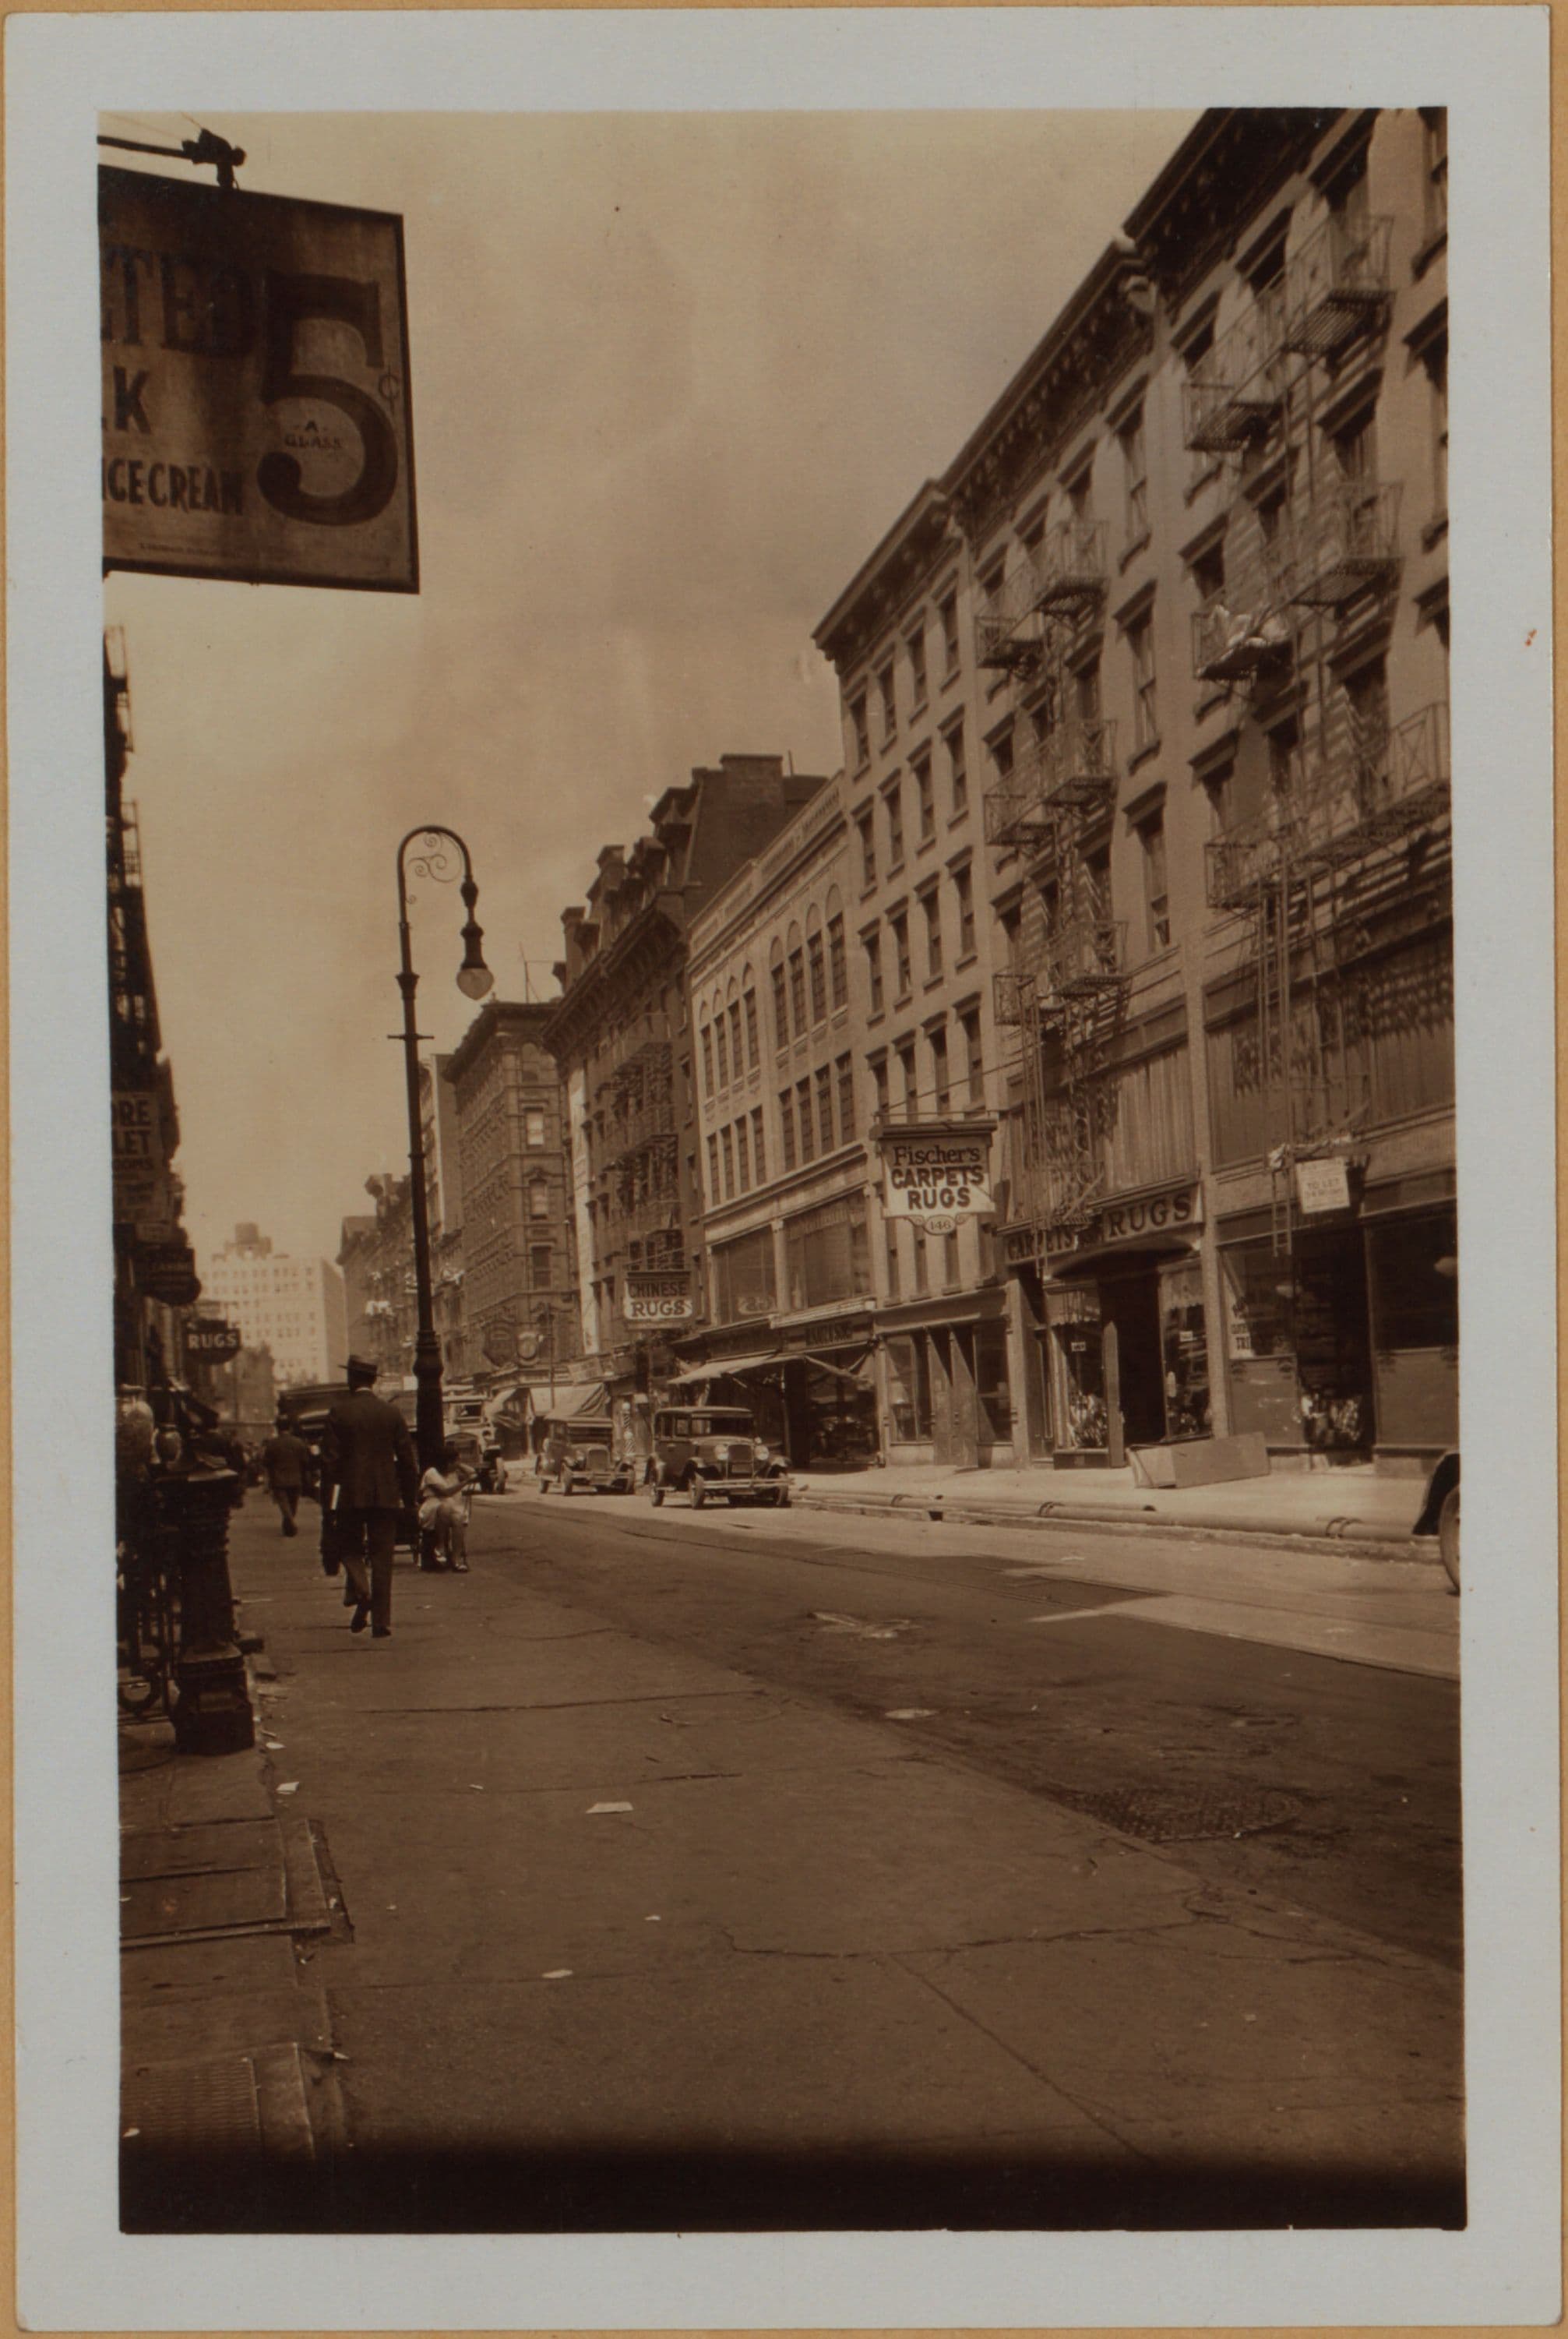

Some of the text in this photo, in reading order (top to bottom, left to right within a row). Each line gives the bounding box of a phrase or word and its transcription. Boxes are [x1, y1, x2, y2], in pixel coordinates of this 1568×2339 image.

[102, 245, 255, 358] TED
[148, 461, 245, 516] CREAM
[893, 1145, 981, 1166] Fischer's
[891, 1165, 984, 1189] CARPETS
[907, 1187, 971, 1209] RUGS
[929, 1220, 951, 1230] 146
[1108, 1194, 1192, 1238] RUGS
[629, 1281, 686, 1298] CHINESE
[631, 1299, 685, 1317] RUGS
[189, 1332, 237, 1349] RUGS
